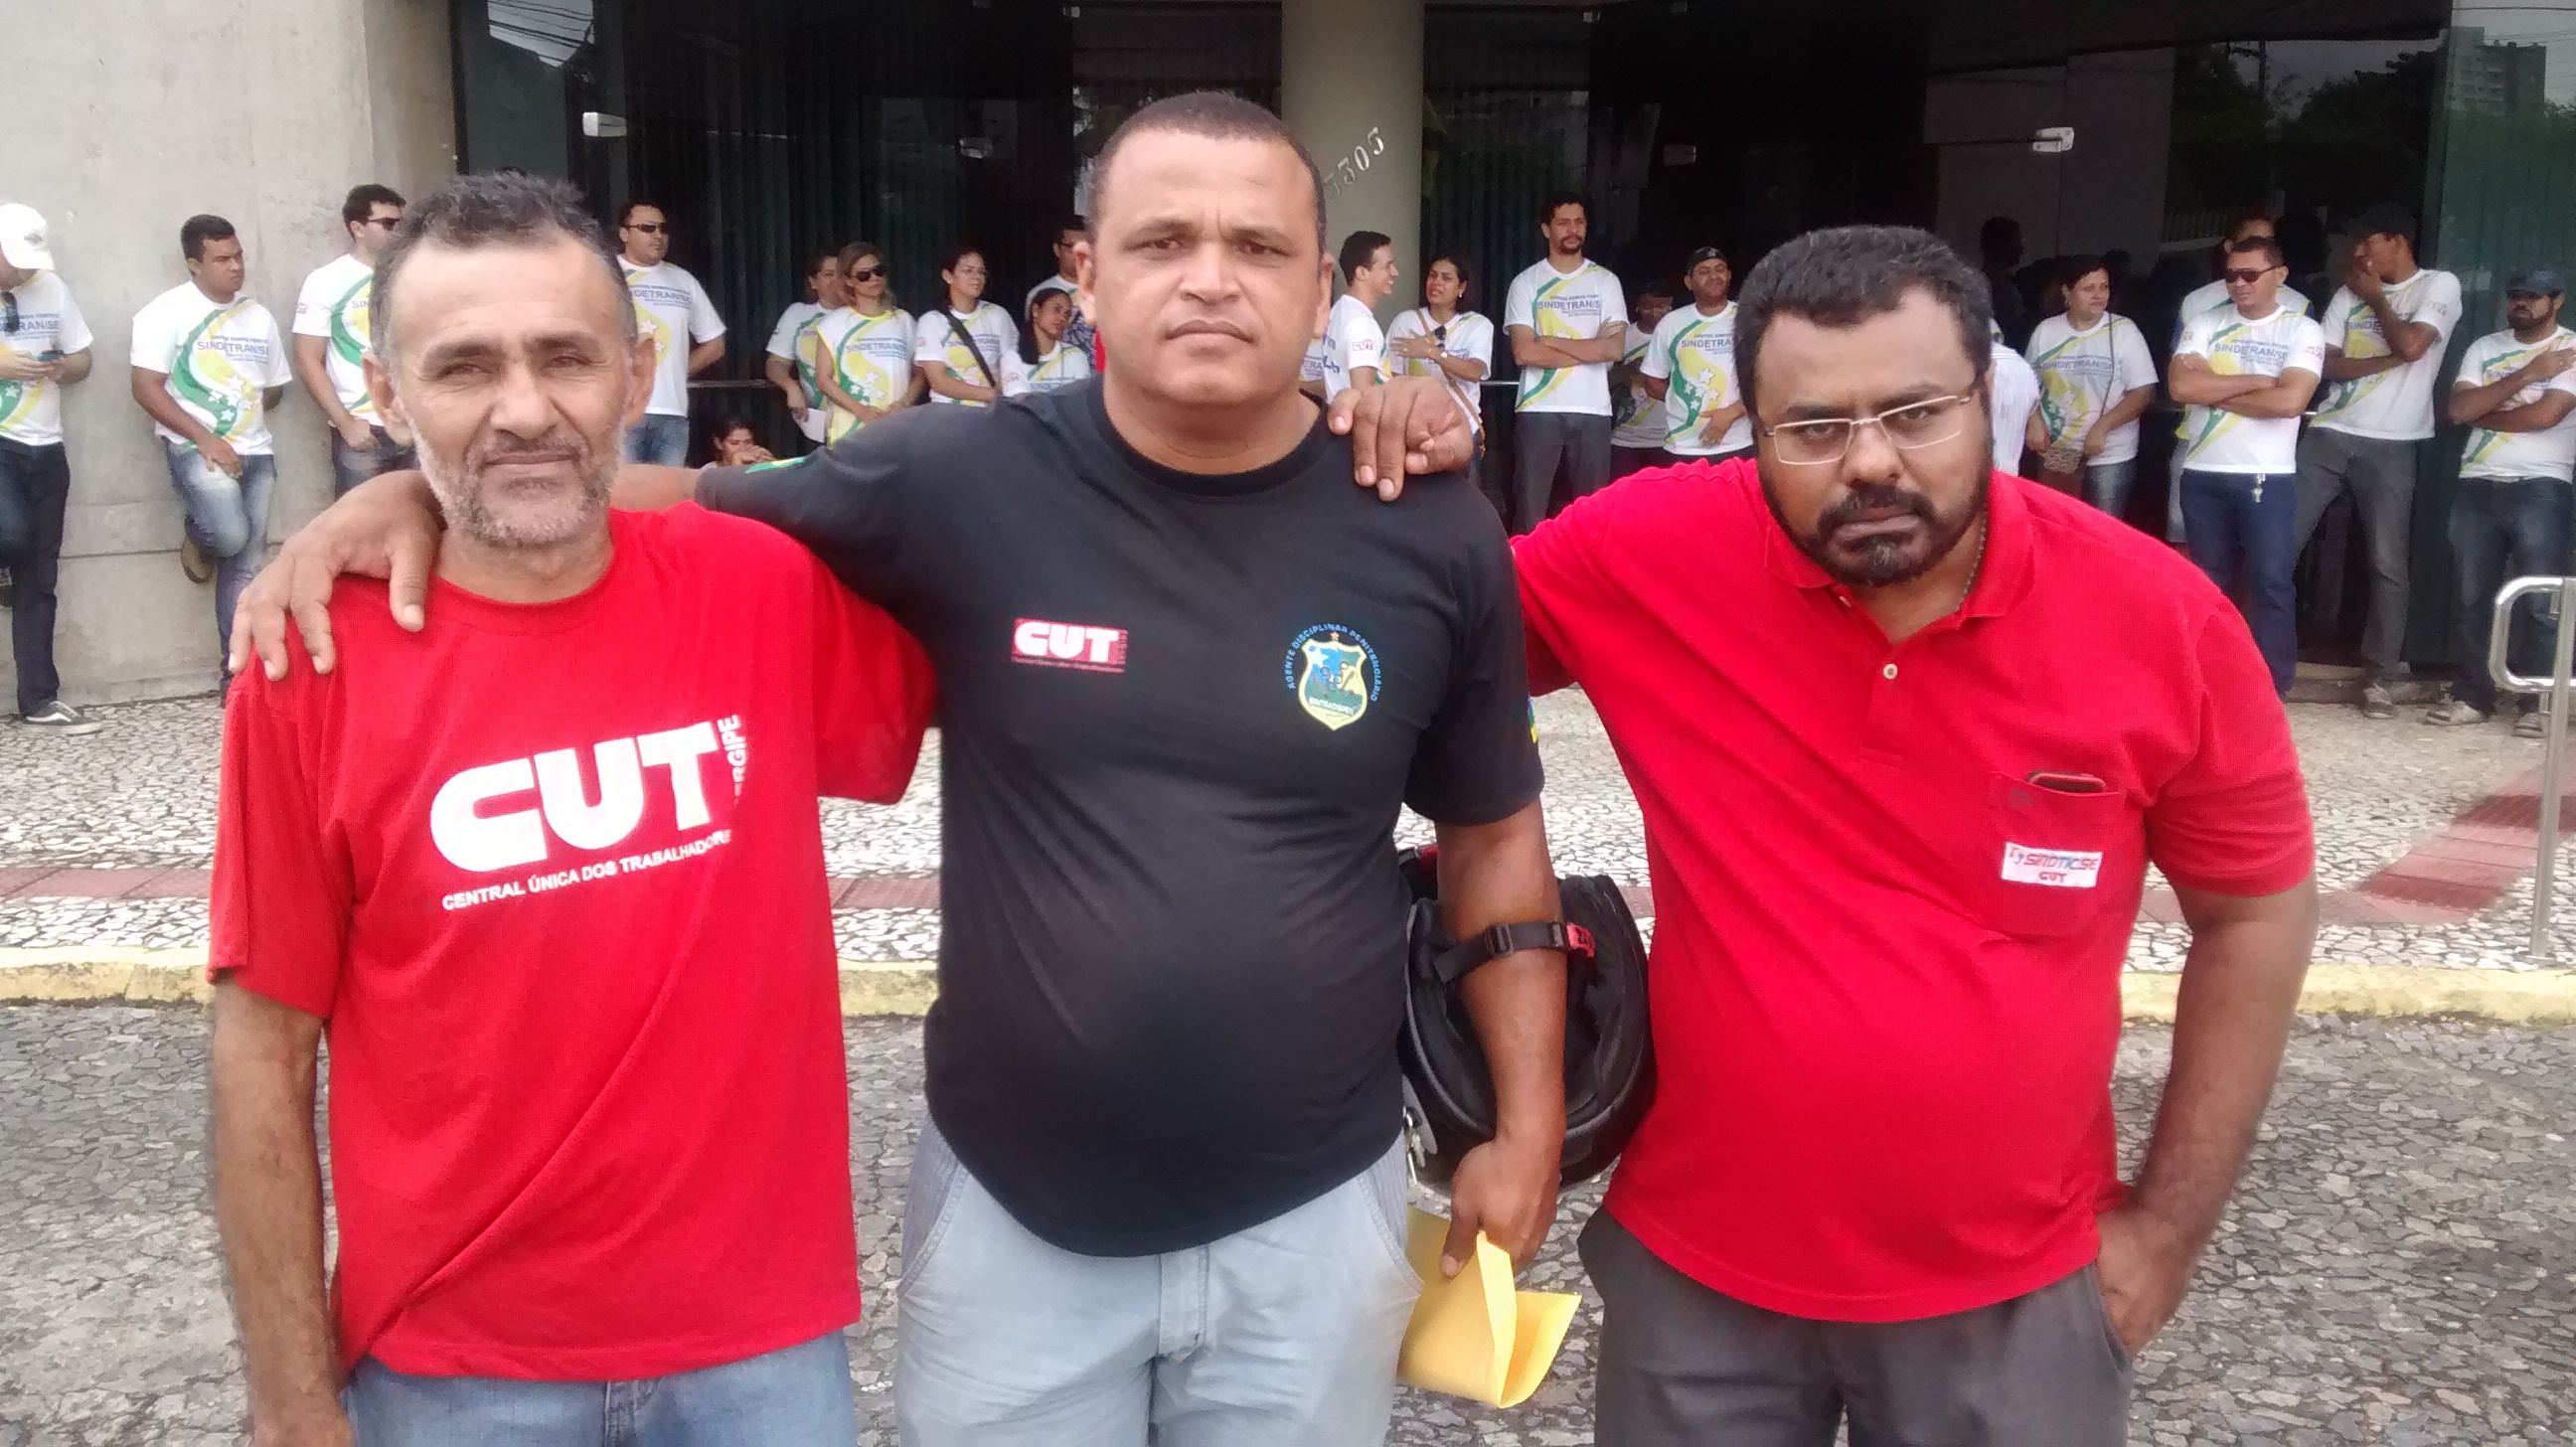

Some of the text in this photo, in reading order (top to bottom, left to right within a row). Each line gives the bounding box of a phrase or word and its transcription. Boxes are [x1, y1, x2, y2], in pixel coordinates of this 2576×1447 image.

[1014, 621, 1120, 663] CUT
[1291, 623, 1348, 649] DISCIPLINAR
[430, 722, 720, 873] CUT
[442, 882, 526, 910] CENTRAL
[529, 871, 580, 893] ÚNICA
[582, 861, 617, 882] DOS
[2038, 872, 2068, 883] CUT
